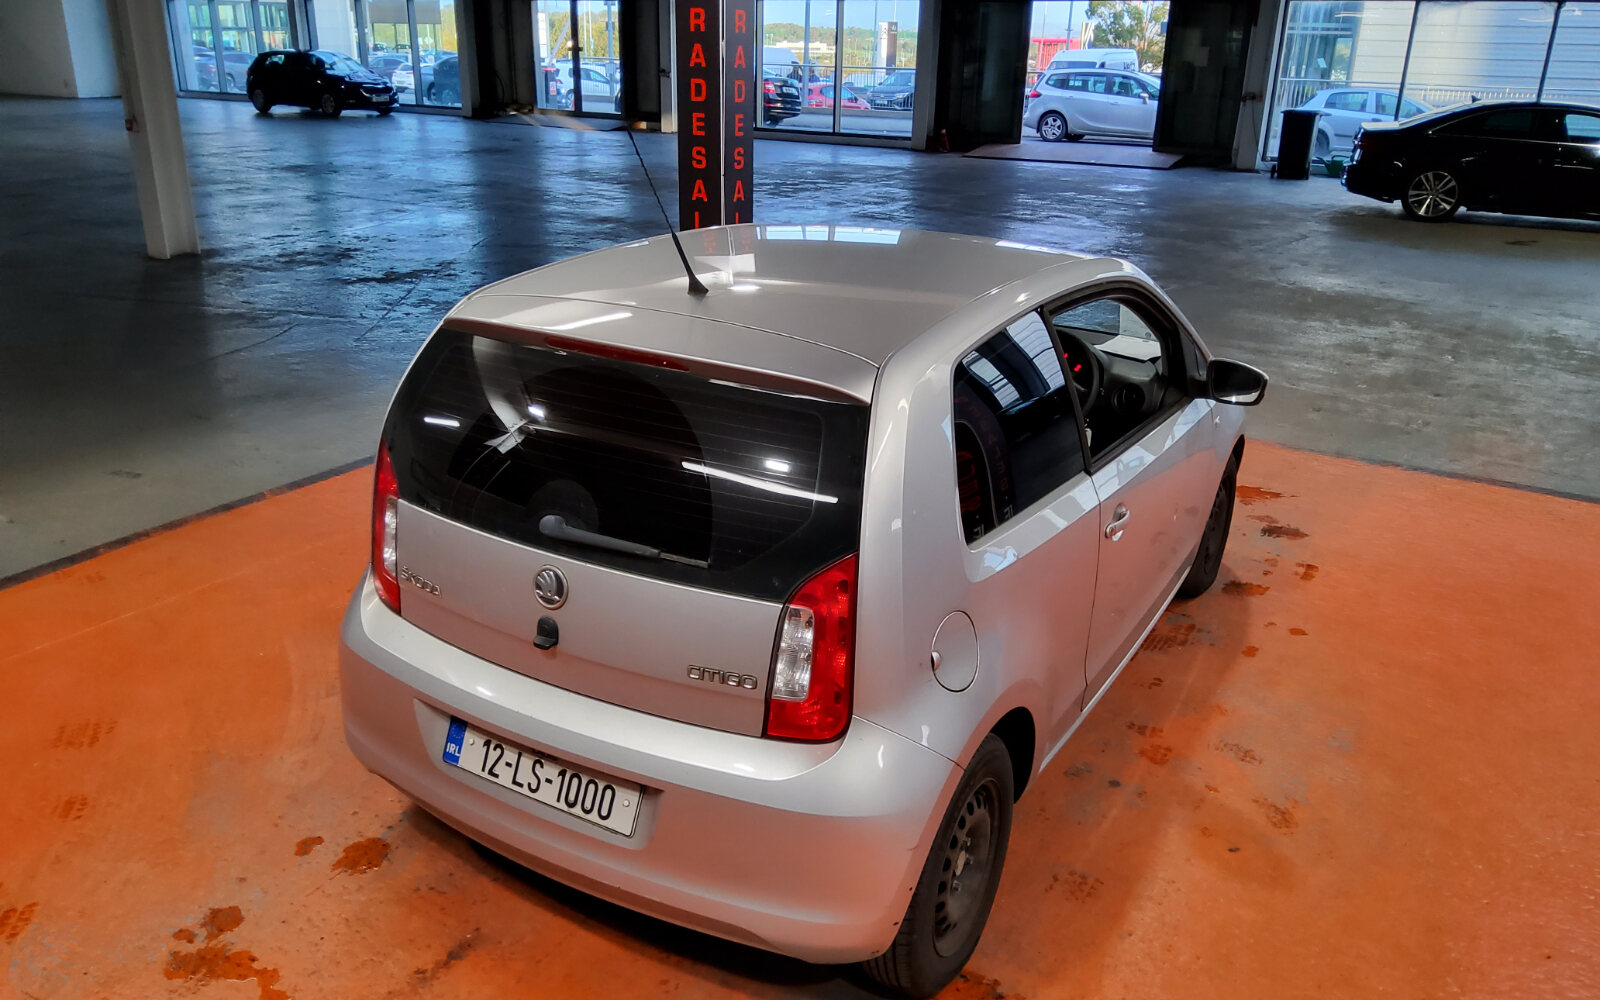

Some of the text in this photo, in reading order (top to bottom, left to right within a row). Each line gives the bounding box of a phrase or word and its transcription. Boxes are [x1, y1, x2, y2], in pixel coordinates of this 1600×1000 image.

[401, 566, 442, 597] ŠKODA
[687, 665, 758, 690] CITIGO
[446, 742, 461, 757] IRL
[481, 739, 616, 821] 12-LS-1000
